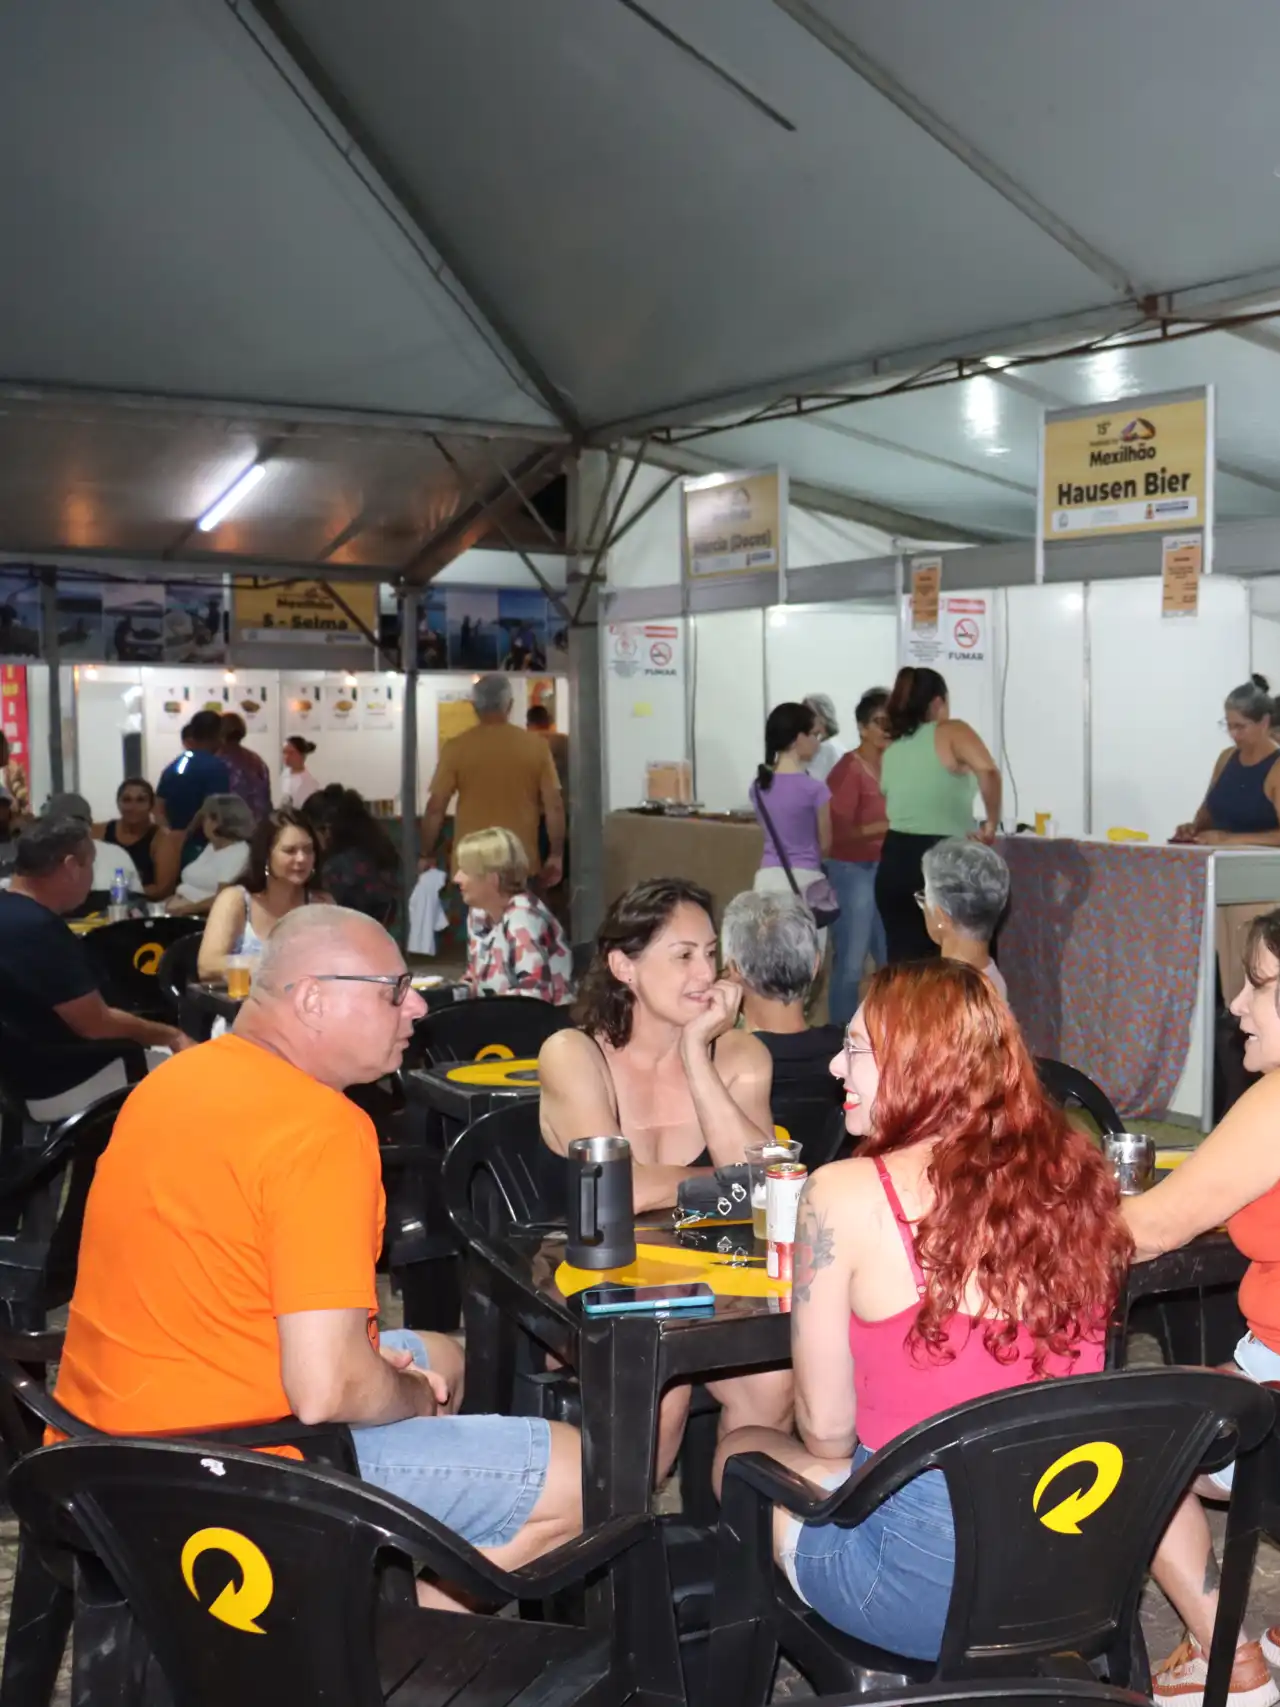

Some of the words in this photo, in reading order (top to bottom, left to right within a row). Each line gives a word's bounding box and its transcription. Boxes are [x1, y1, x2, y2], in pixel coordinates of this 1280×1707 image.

[1089, 442, 1156, 468] Mexilhão
[1058, 479, 1137, 505] Hausen
[1144, 467, 1190, 495] Bier
[948, 652, 984, 661] FUMAR
